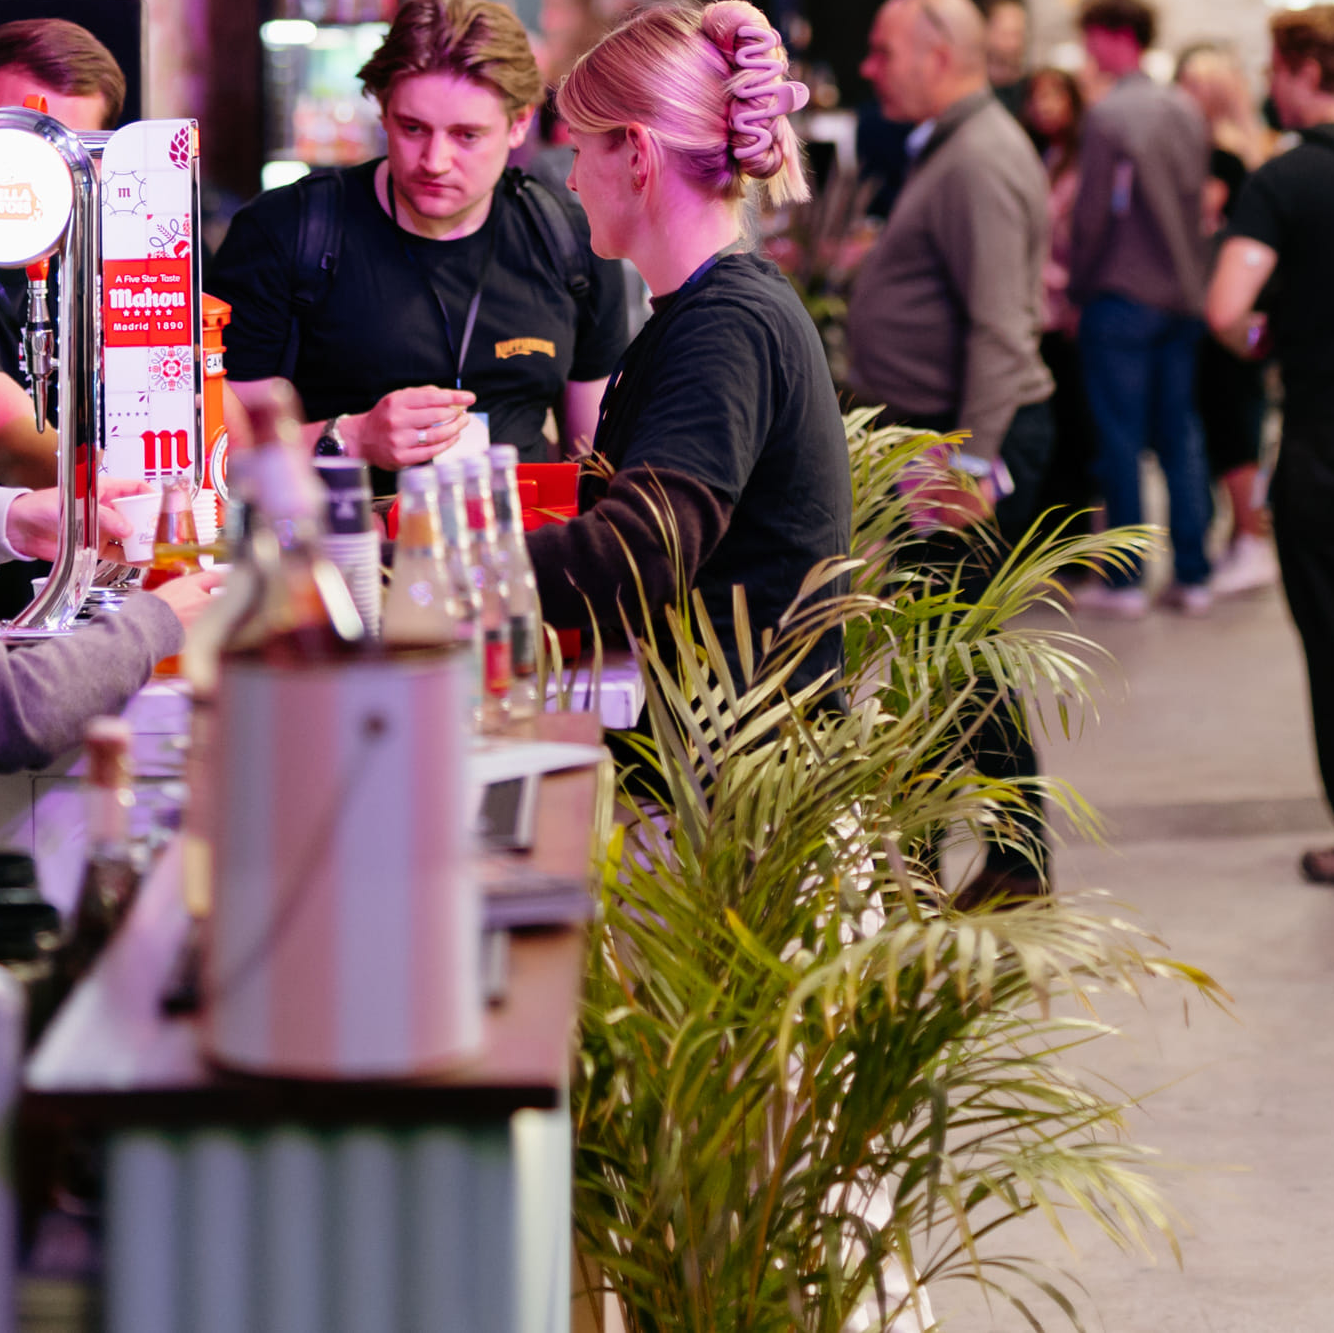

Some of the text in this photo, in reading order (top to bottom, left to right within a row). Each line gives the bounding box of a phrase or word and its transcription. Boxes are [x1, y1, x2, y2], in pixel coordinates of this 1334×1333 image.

[115, 273, 181, 283] A Five Star Taste
[108, 287, 186, 308] Mahou
[113, 321, 184, 331] Madrid 1890
